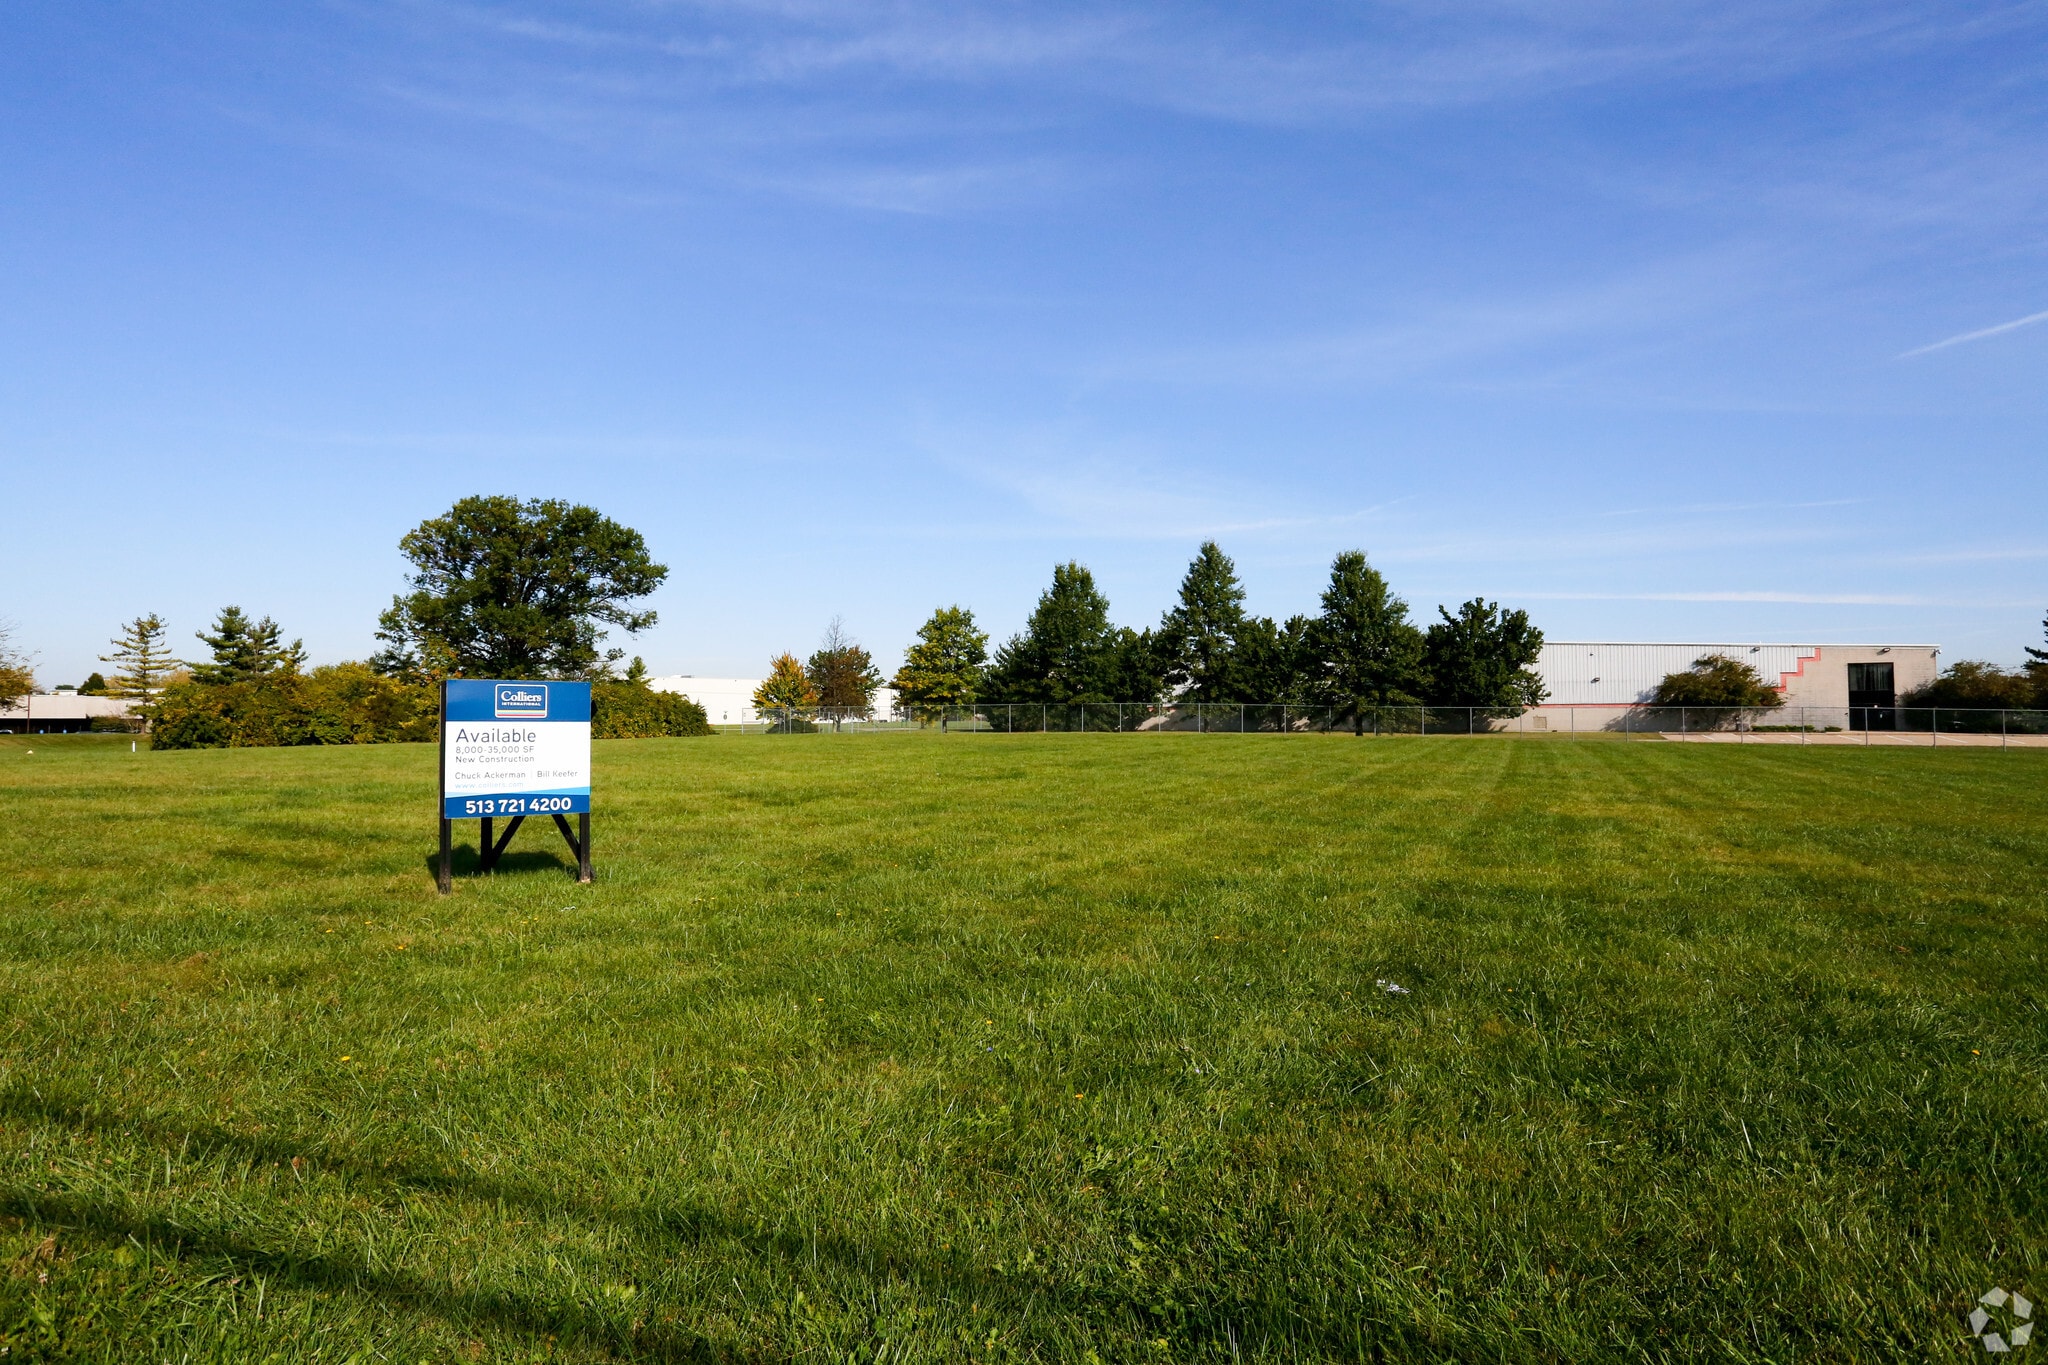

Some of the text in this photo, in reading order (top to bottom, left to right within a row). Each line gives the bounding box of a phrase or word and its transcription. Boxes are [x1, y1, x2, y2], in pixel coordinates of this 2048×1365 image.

[501, 691, 542, 701] Colliers
[455, 728, 536, 743] Available
[455, 746, 520, 755] 8,000-35,000
[479, 755, 535, 763] Construction
[455, 771, 526, 780] Chuck Ackerman
[465, 797, 572, 814] 513 721 4200
